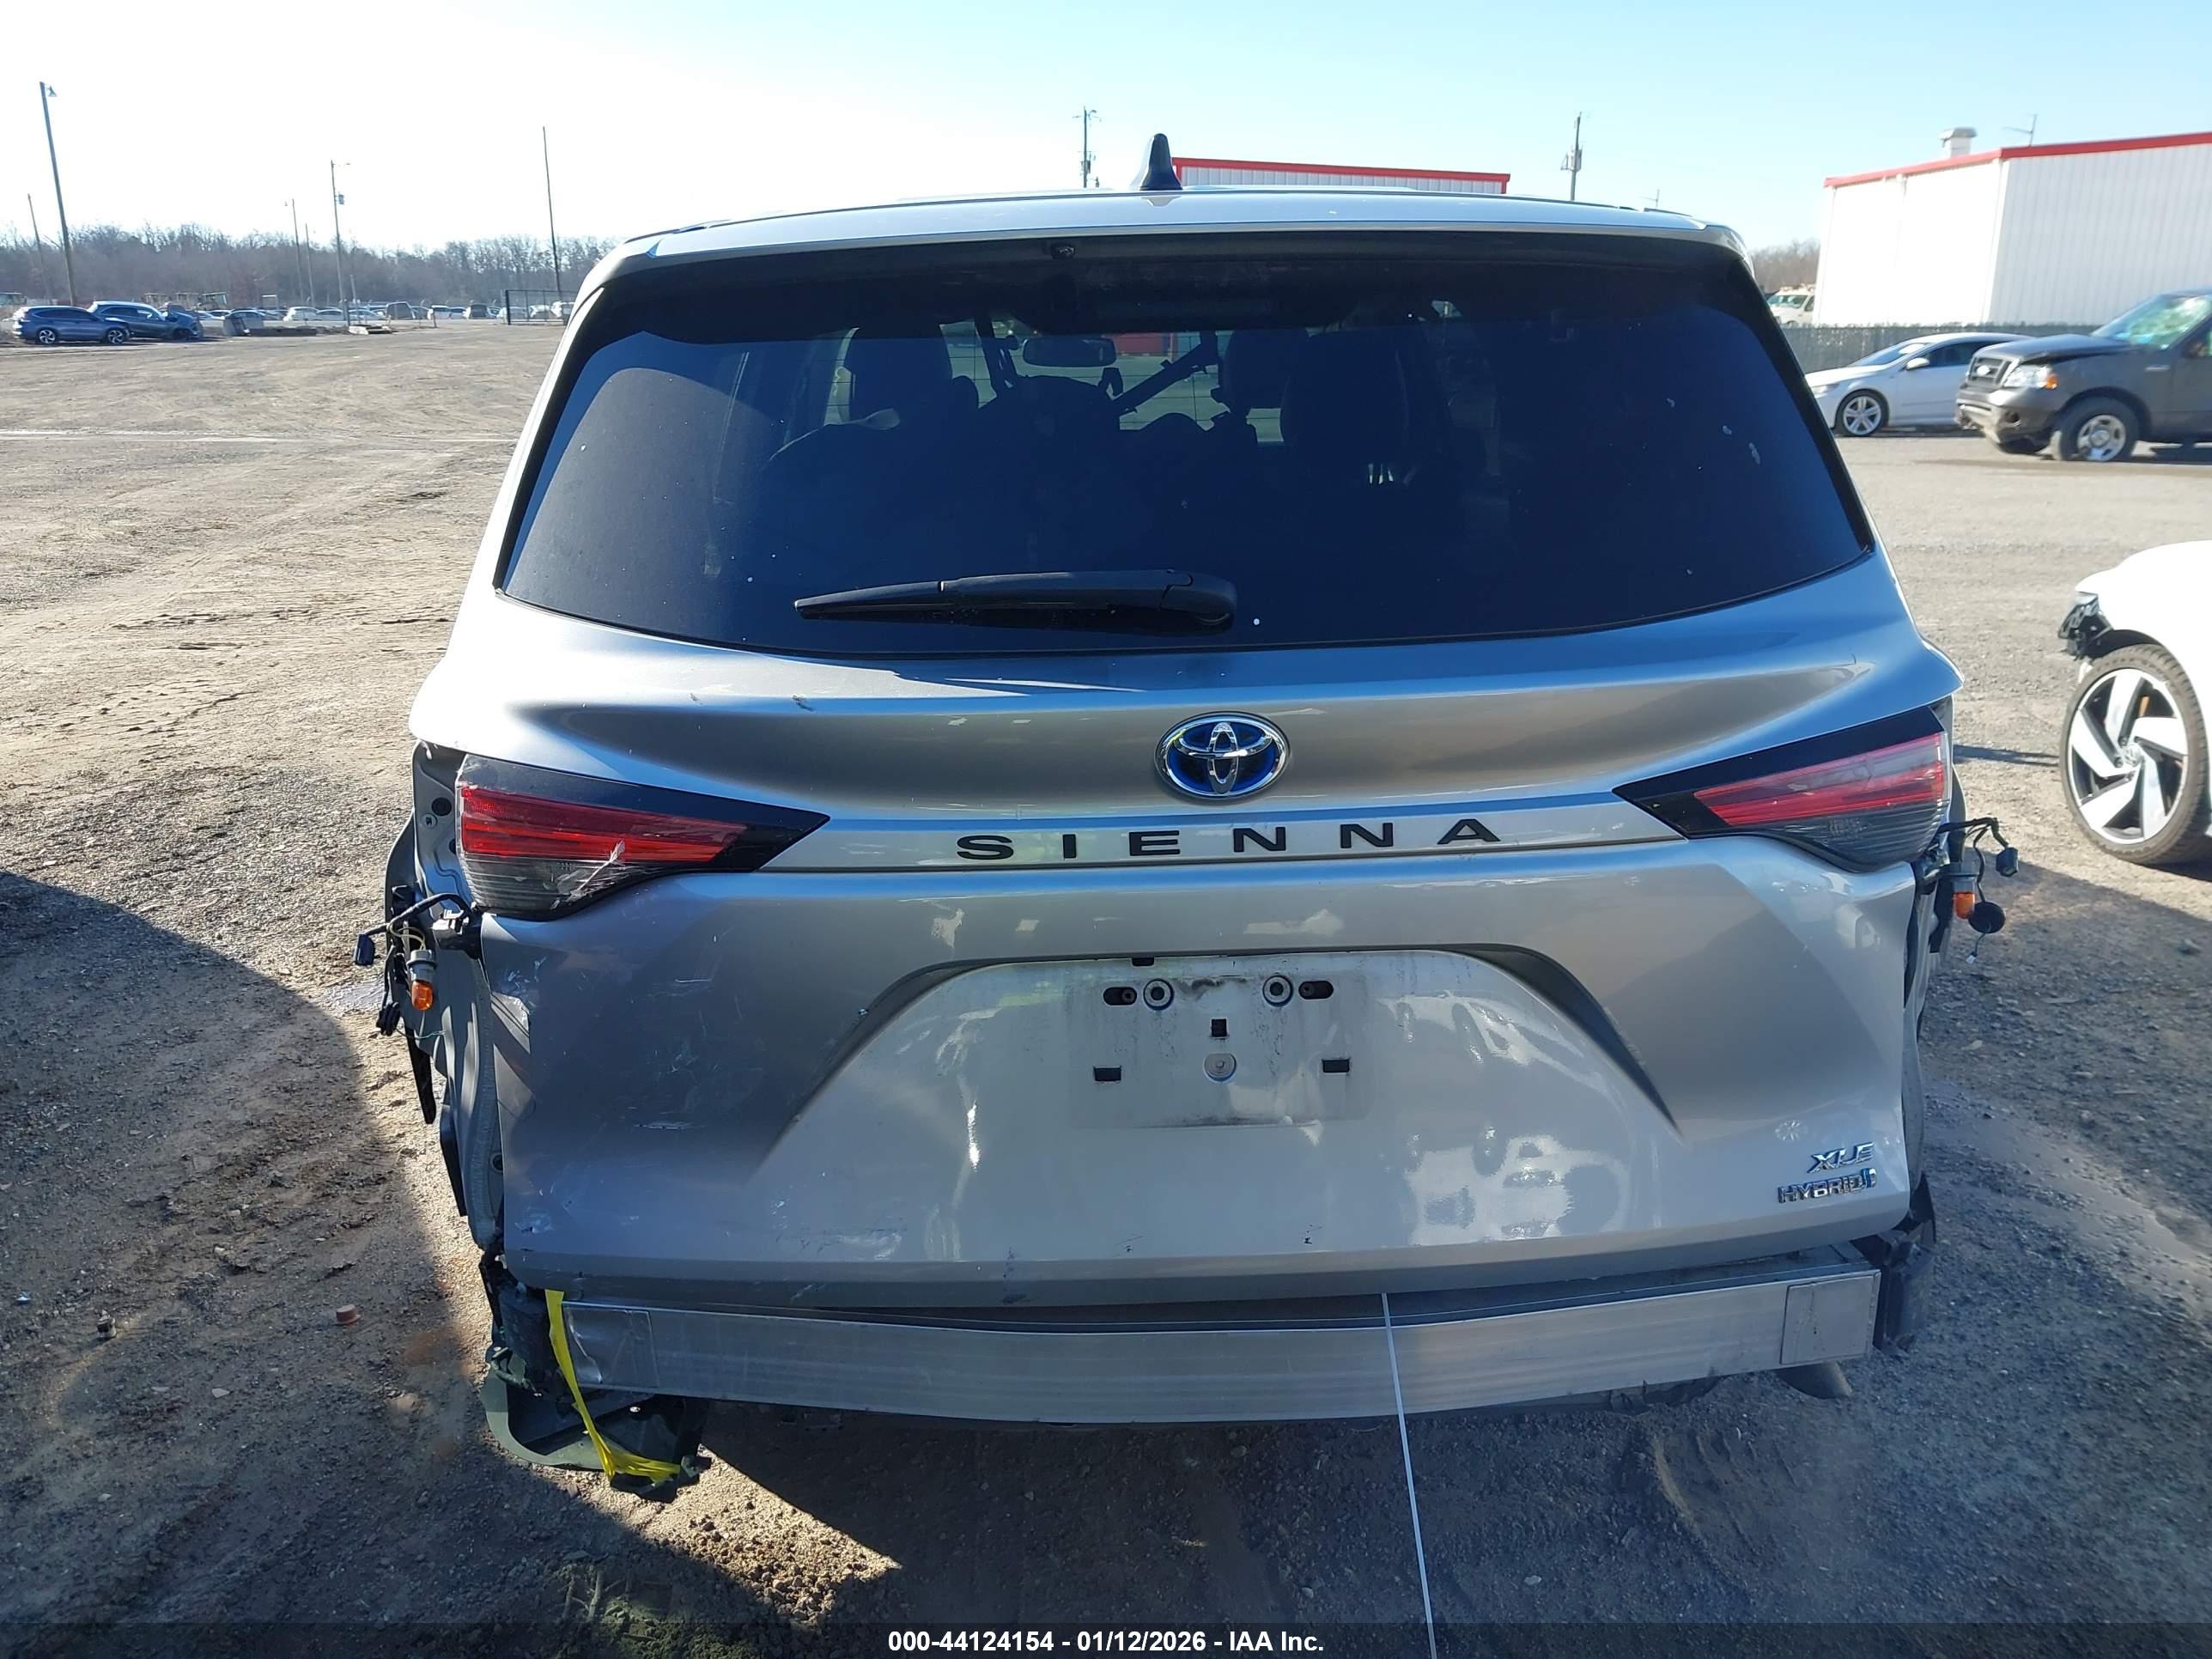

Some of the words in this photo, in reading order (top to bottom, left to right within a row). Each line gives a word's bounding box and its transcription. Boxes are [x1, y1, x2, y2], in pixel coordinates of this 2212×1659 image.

[957, 818, 1501, 860] SIENNA
[1807, 1141, 1875, 1174] XLE
[1778, 1174, 1864, 1203] HYBRID
